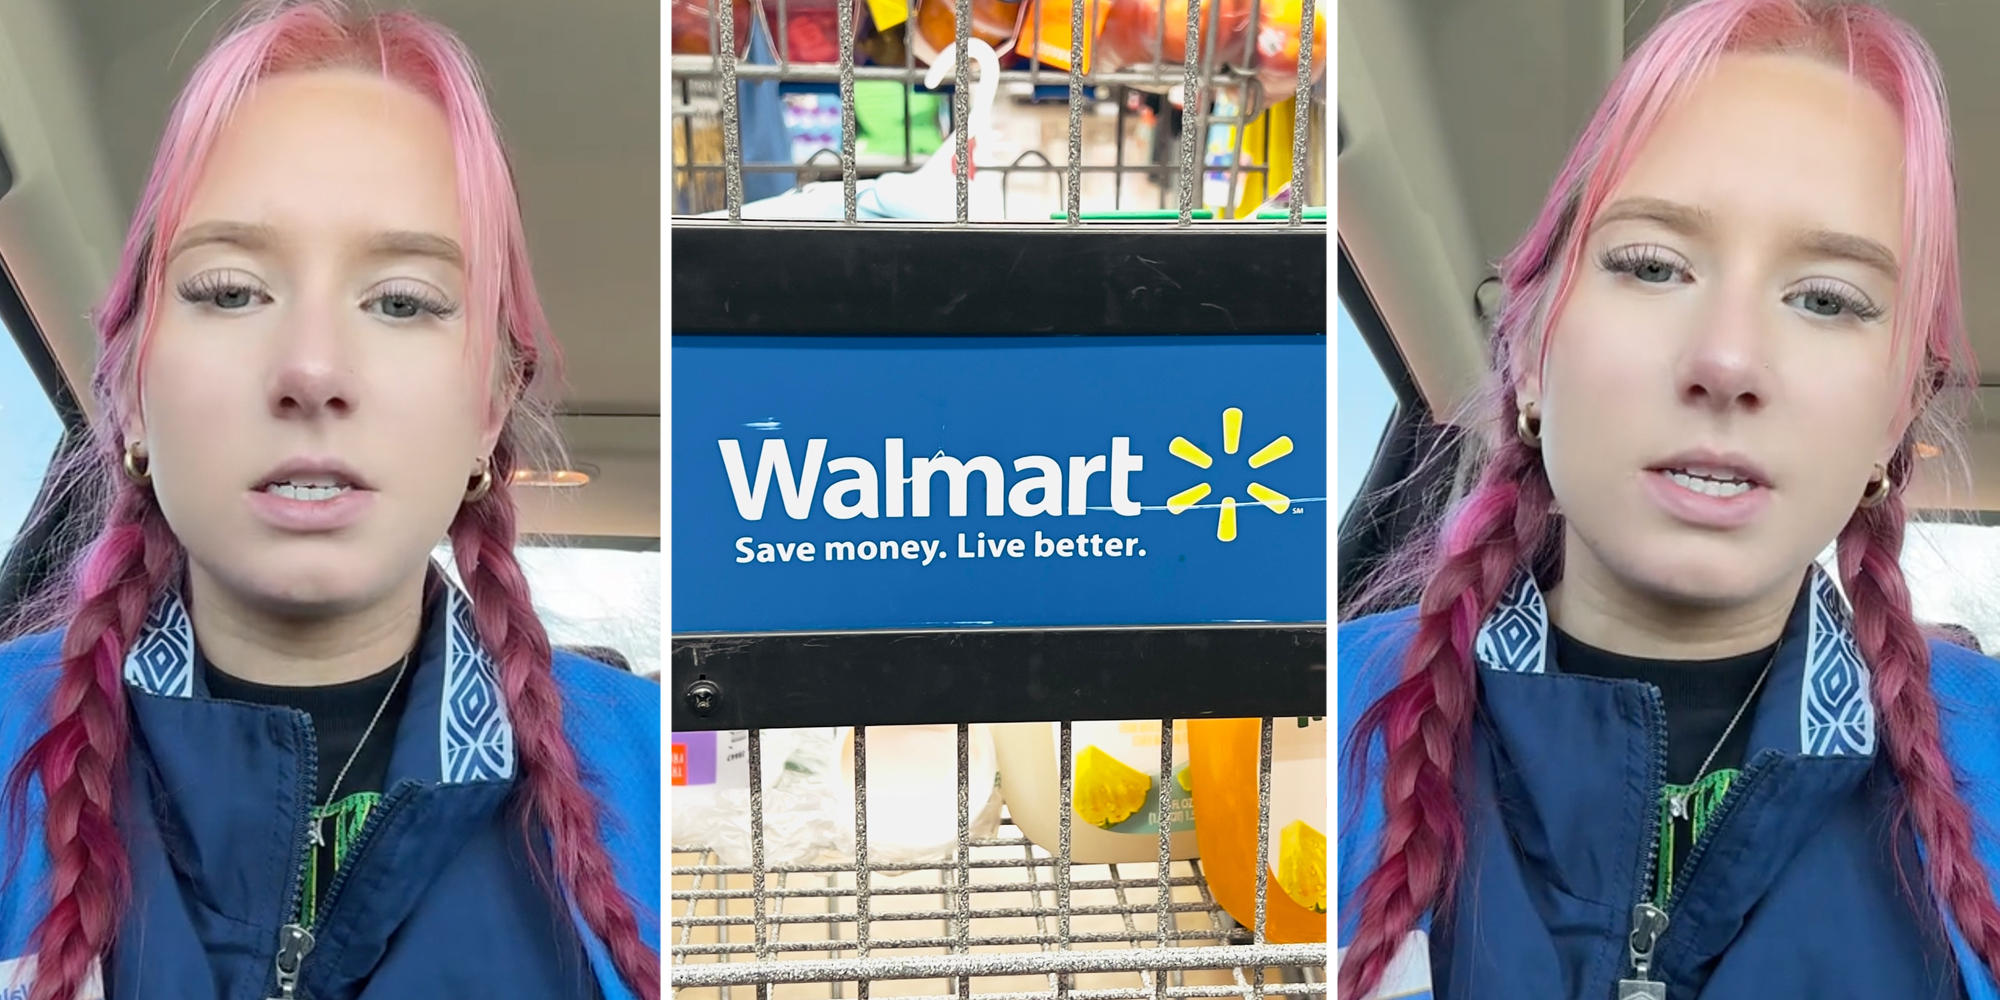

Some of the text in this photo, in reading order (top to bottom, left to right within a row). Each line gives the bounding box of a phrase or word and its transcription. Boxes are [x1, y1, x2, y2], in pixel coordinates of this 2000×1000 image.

[717, 437, 1144, 520] Walmart
[1291, 506, 1304, 515] SM
[736, 531, 1147, 566] Save money. Live better.
